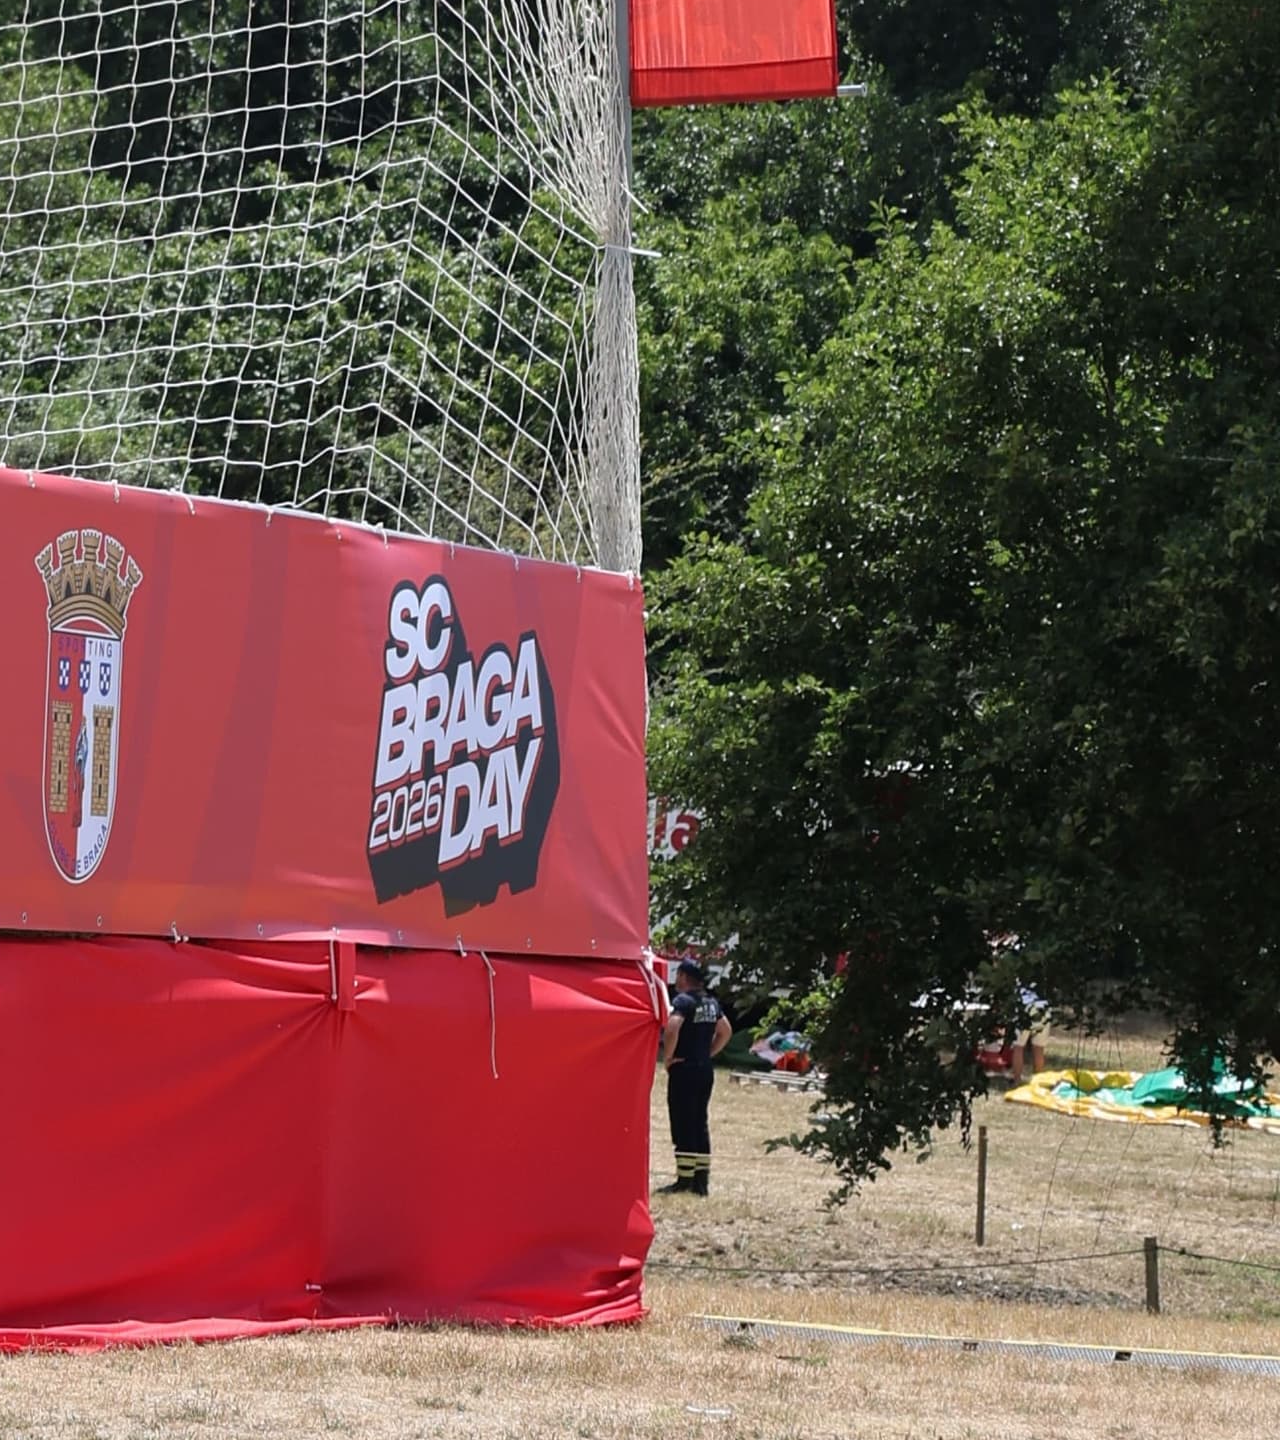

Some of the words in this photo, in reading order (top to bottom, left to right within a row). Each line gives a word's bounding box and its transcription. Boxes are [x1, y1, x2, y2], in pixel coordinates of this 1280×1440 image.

[386, 583, 452, 679] SC
[374, 638, 543, 788] BRAGA
[83, 824, 107, 871] BRAGA
[369, 774, 443, 849] 2026
[438, 737, 542, 864] DAY
